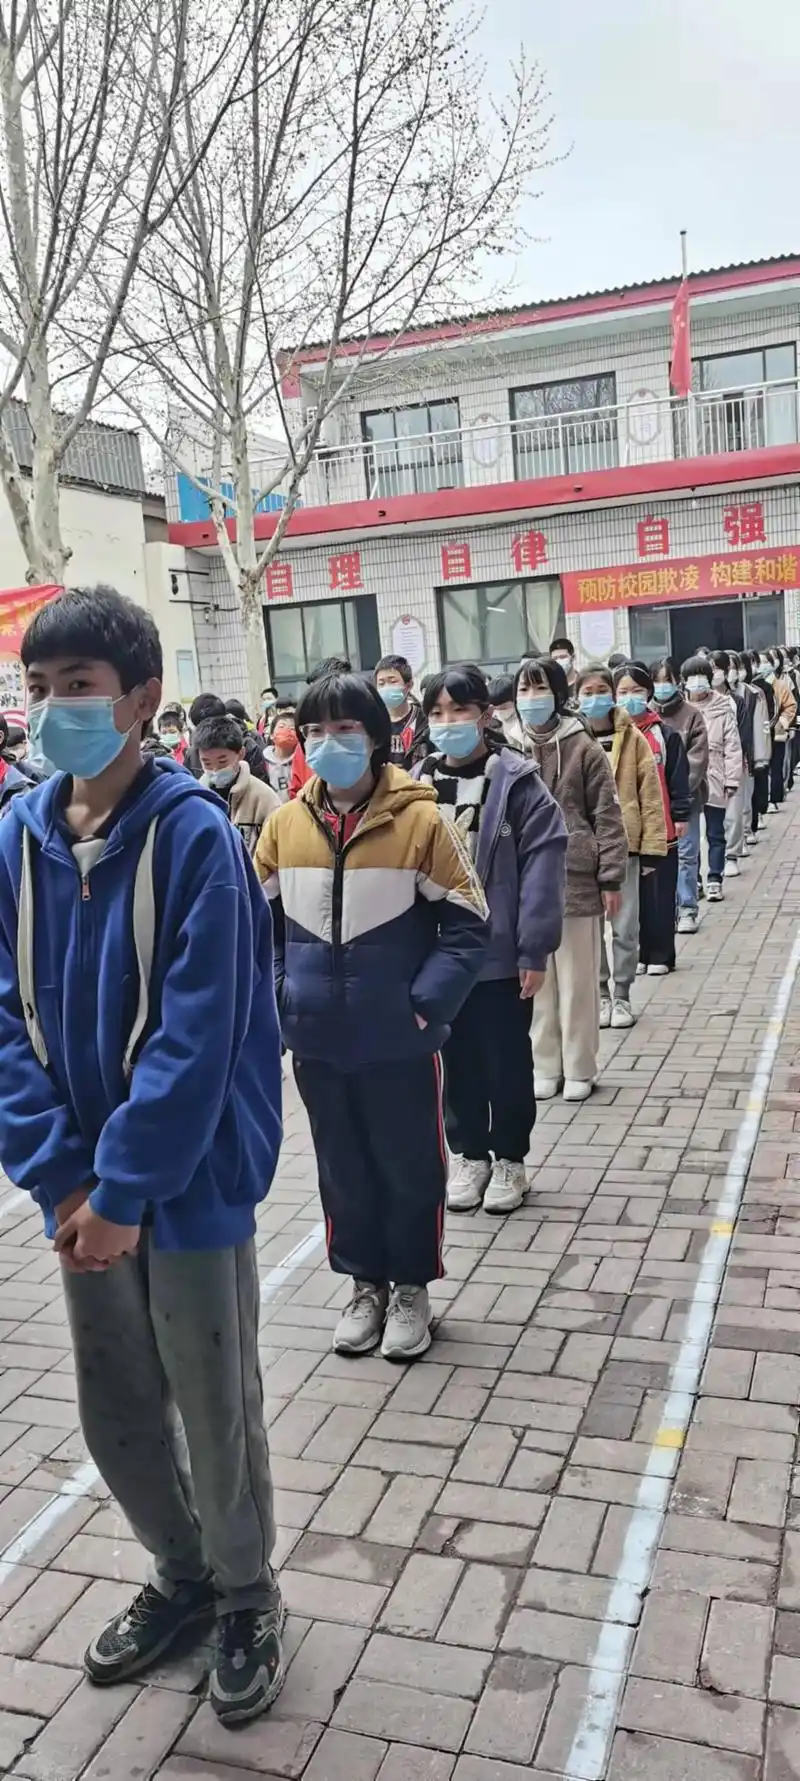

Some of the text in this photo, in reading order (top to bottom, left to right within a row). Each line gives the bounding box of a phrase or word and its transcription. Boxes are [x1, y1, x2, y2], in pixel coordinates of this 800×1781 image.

[578, 552, 798, 604] 预防校园欺凌 构建和谐
